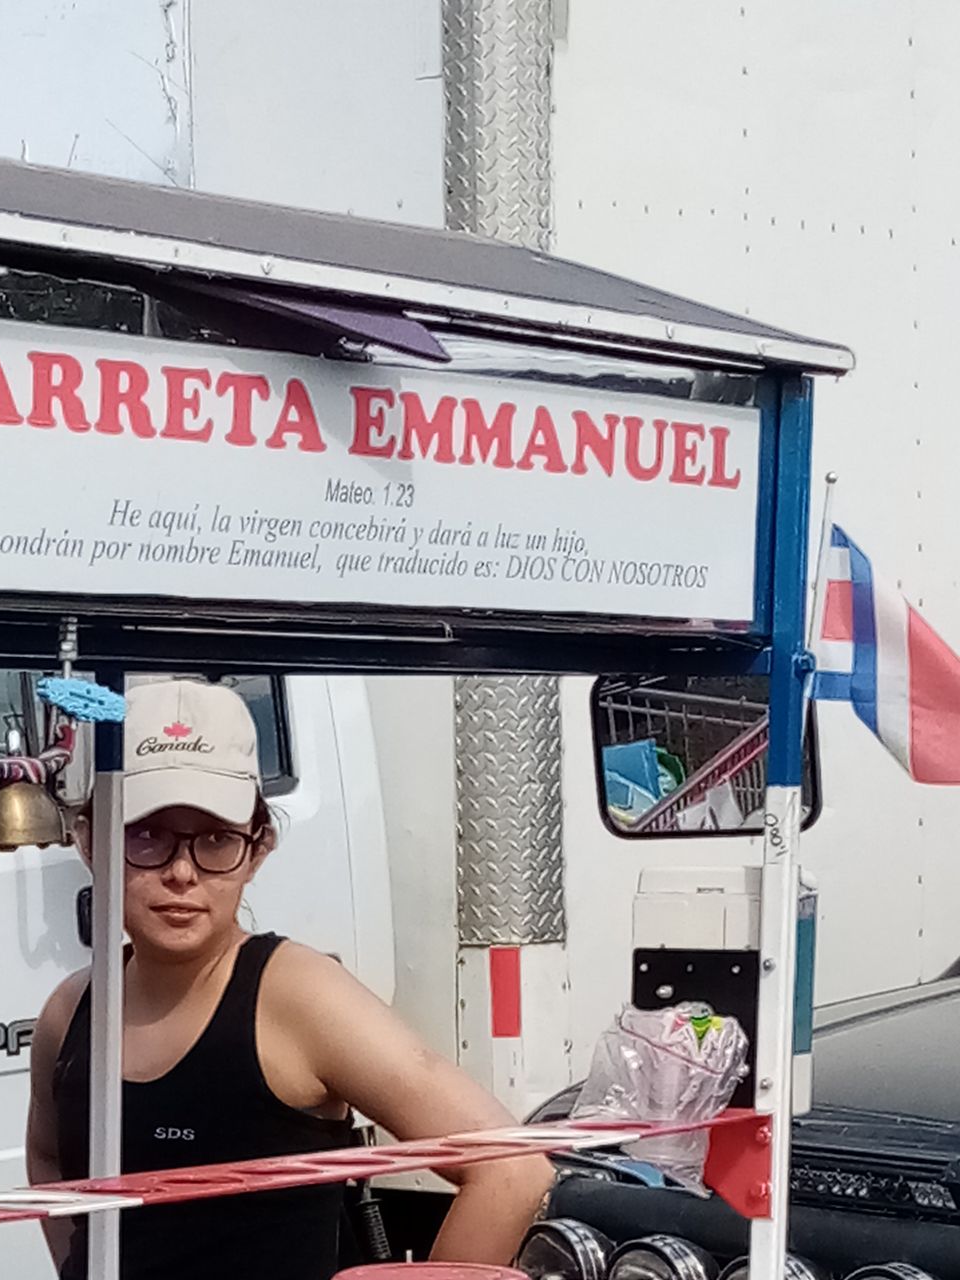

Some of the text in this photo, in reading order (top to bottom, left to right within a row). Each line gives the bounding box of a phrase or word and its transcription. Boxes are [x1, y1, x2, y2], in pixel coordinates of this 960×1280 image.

[347, 385, 742, 489] EMMANUEL
[108, 499, 142, 528] He
[148, 503, 202, 537] aquí,
[211, 505, 232, 533] la
[240, 509, 302, 543] virgen
[309, 515, 407, 543] concebirá
[408, 526, 424, 551] y
[428, 519, 473, 547] dará
[477, 530, 489, 547] a
[494, 523, 521, 549] luz
[525, 534, 548, 551] un
[88, 539, 133, 567] por
[138, 536, 221, 565] nombre
[227, 539, 322, 573] Emanuel,
[336, 553, 372, 578] que
[377, 550, 468, 577] traducido
[474, 560, 500, 579] es:
[505, 555, 558, 581] DIOS
[561, 557, 605, 584] CON
[607, 561, 709, 589] NOSOTROS
[154, 1126, 195, 1141] SDS
